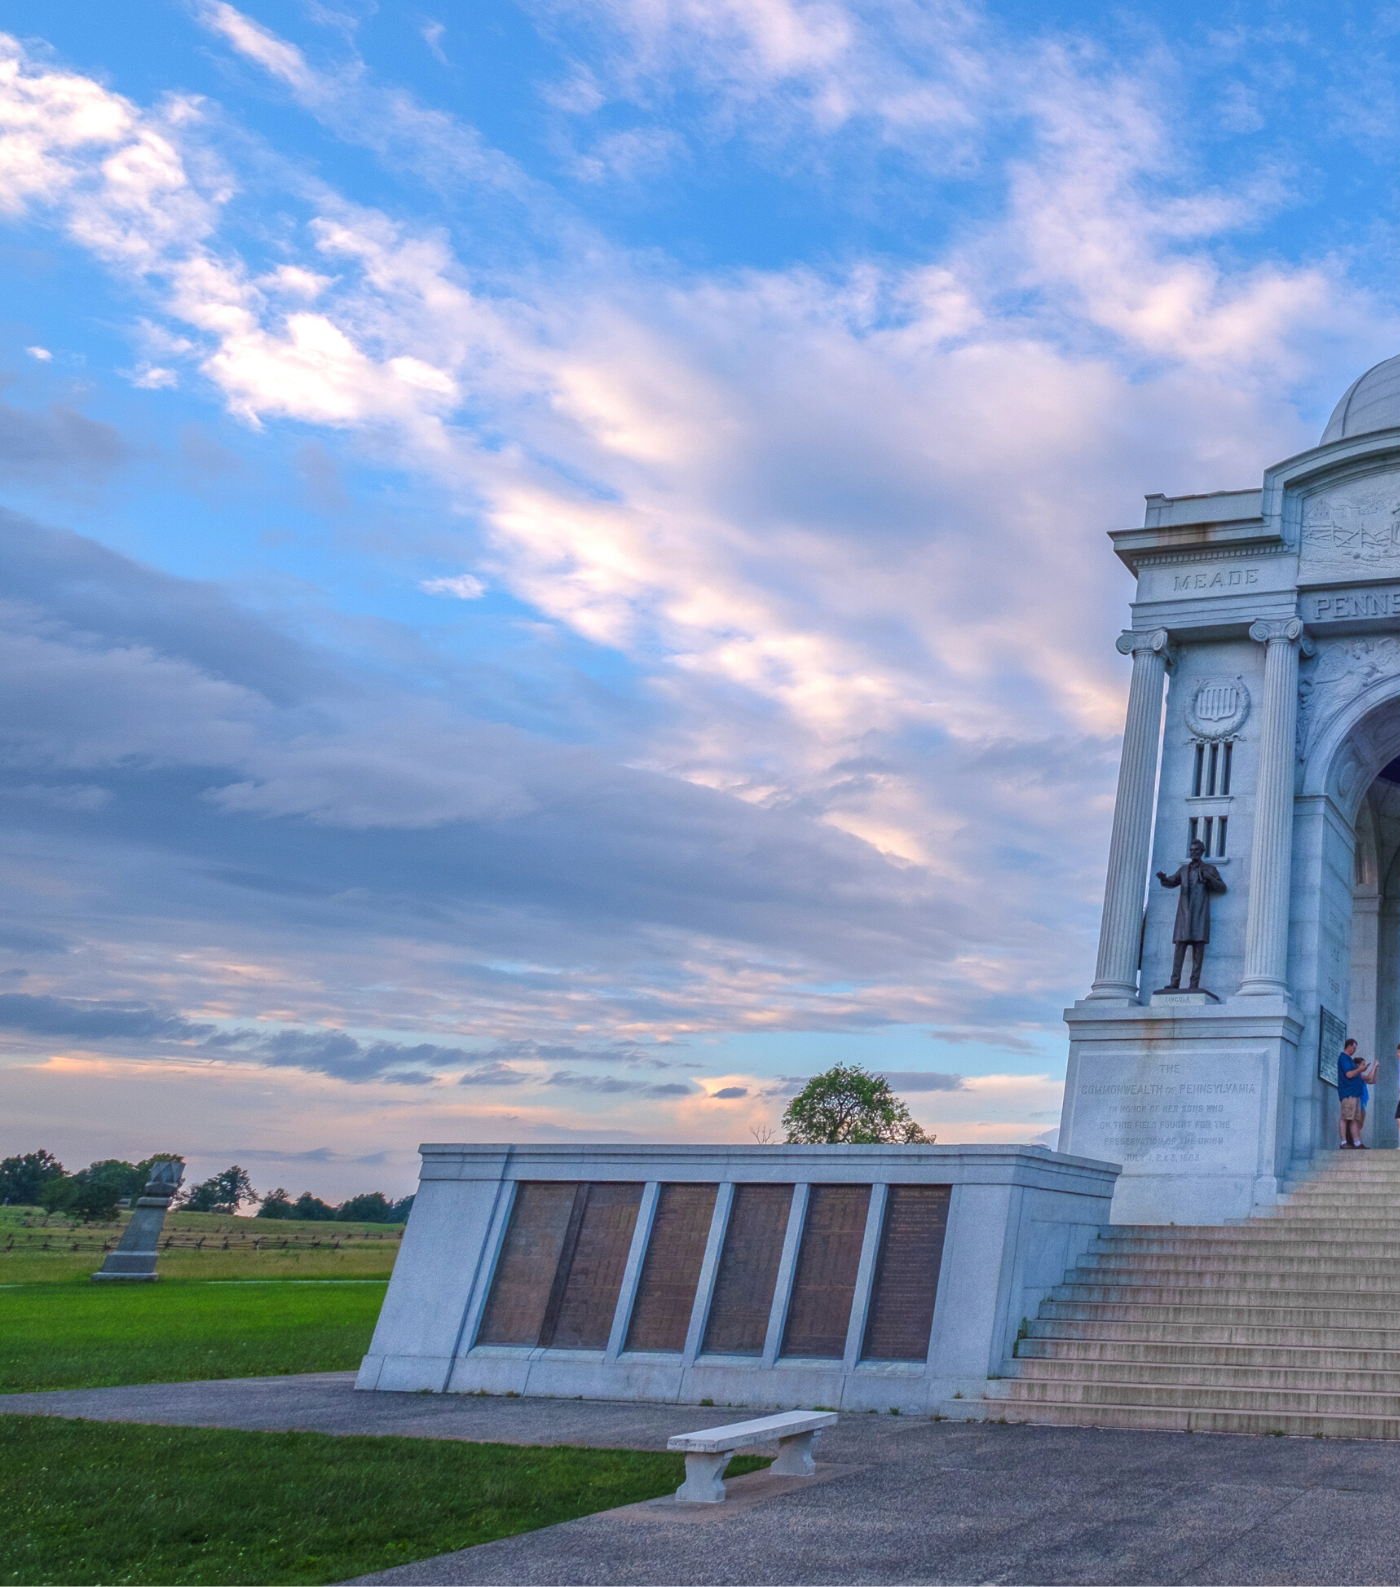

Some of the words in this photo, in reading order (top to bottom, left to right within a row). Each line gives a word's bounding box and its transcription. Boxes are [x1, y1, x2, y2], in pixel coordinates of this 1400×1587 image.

[1173, 568, 1259, 592] MEADE
[1159, 1064, 1181, 1074] THE
[1081, 1084, 1164, 1095] COMMONWEALTH
[1179, 1083, 1256, 1095] PENNSYLVANIA
[1109, 1105, 1118, 1113] IN
[1119, 1105, 1147, 1113] HONOR
[1149, 1105, 1160, 1113] OF
[1162, 1105, 1178, 1113] HER
[1181, 1105, 1204, 1113] SONS
[1206, 1105, 1224, 1113] WHO
[1099, 1121, 1113, 1130] ON
[1114, 1121, 1136, 1129] THIS
[1136, 1121, 1157, 1129] FIELD
[1159, 1121, 1191, 1129] FOUGHT
[1194, 1121, 1211, 1129] FOR
[1214, 1120, 1231, 1129] THE
[1104, 1137, 1164, 1146] PRESERVATION
[1165, 1137, 1177, 1146] OF
[1179, 1137, 1195, 1146] THE
[1197, 1137, 1224, 1146] UNION
[1123, 1153, 1146, 1162] JULY
